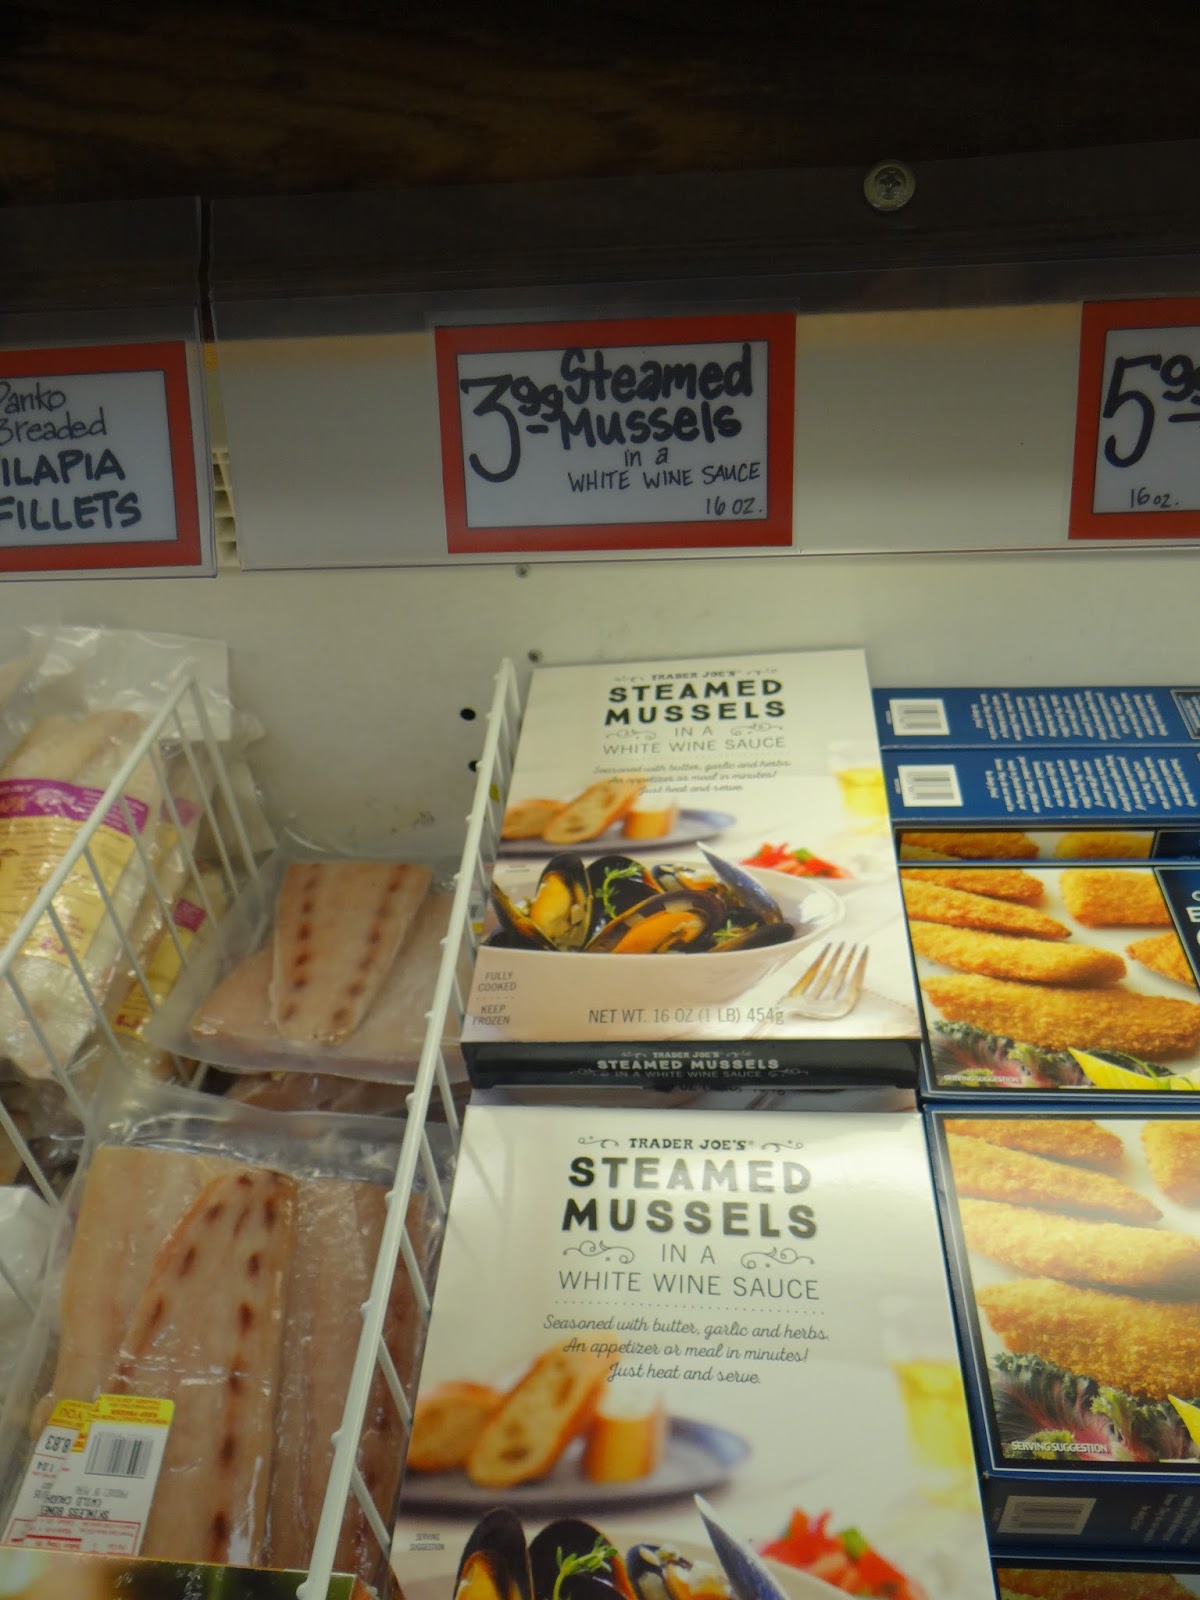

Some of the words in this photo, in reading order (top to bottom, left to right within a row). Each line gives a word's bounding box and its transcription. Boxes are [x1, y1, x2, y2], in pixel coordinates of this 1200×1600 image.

[560, 342, 754, 405] Steamed
[562, 400, 742, 450] Mussels
[0, 449, 126, 487] ILAPIA
[624, 449, 642, 468] in
[655, 447, 669, 466] a
[567, 469, 630, 493] WHITE
[643, 468, 694, 489] WINE
[701, 461, 761, 485] SAUCE
[652, 672, 698, 681] TRADER
[702, 670, 736, 679] JOE'S
[608, 679, 782, 703] STEAMED
[604, 701, 785, 726] MUSSELS
[675, 727, 693, 737] IN
[702, 726, 713, 736] A
[602, 742, 661, 755] WHITE
[669, 739, 717, 752] WINE
[724, 737, 786, 750] SAUCE
[737, 761, 758, 769] and
[485, 971, 513, 981] FULLY
[477, 982, 517, 992] COOKED
[472, 1014, 510, 1025] FROZEN
[481, 1004, 506, 1014] KEEP
[588, 1009, 616, 1024] NET
[622, 1009, 646, 1024] WT.
[653, 1008, 670, 1023] 16
[674, 1008, 693, 1023] OZ
[697, 1007, 711, 1024] (1
[717, 1007, 741, 1024] LB)
[746, 1007, 785, 1025] 454g
[597, 1059, 683, 1070] STEAMED
[690, 1059, 780, 1070] MUSSELS
[652, 1051, 691, 1059] TRADER
[692, 1051, 720, 1059] JOE'S
[629, 1137, 694, 1150] TRADER
[699, 1138, 747, 1151] JOE'S
[567, 1156, 812, 1194] STEAMED
[561, 1198, 817, 1239] MUSSELS
[661, 1243, 687, 1264] IN
[699, 1245, 716, 1265] A
[558, 1270, 642, 1292] WHITE
[652, 1273, 722, 1296] WINE
[733, 1276, 820, 1300] SAUCE
[543, 1314, 614, 1330] Seasoned
[616, 1317, 649, 1332] with
[652, 1318, 700, 1337] butter,
[704, 1322, 749, 1340] garlic
[751, 1324, 781, 1339] and
[783, 1326, 830, 1341] herbs.
[563, 1338, 586, 1352] An
[590, 1340, 660, 1359] appetizer
[663, 1343, 683, 1356] or
[685, 1343, 724, 1358] meal
[726, 1345, 741, 1359] in
[743, 1348, 809, 1363] minutes!
[607, 1362, 644, 1382] Just
[647, 1363, 681, 1380] heat
[683, 1366, 713, 1381] and
[717, 1370, 761, 1384] serve.
[1011, 1441, 1051, 1451] SERVING
[1051, 1442, 1108, 1454] SUGGESTION
